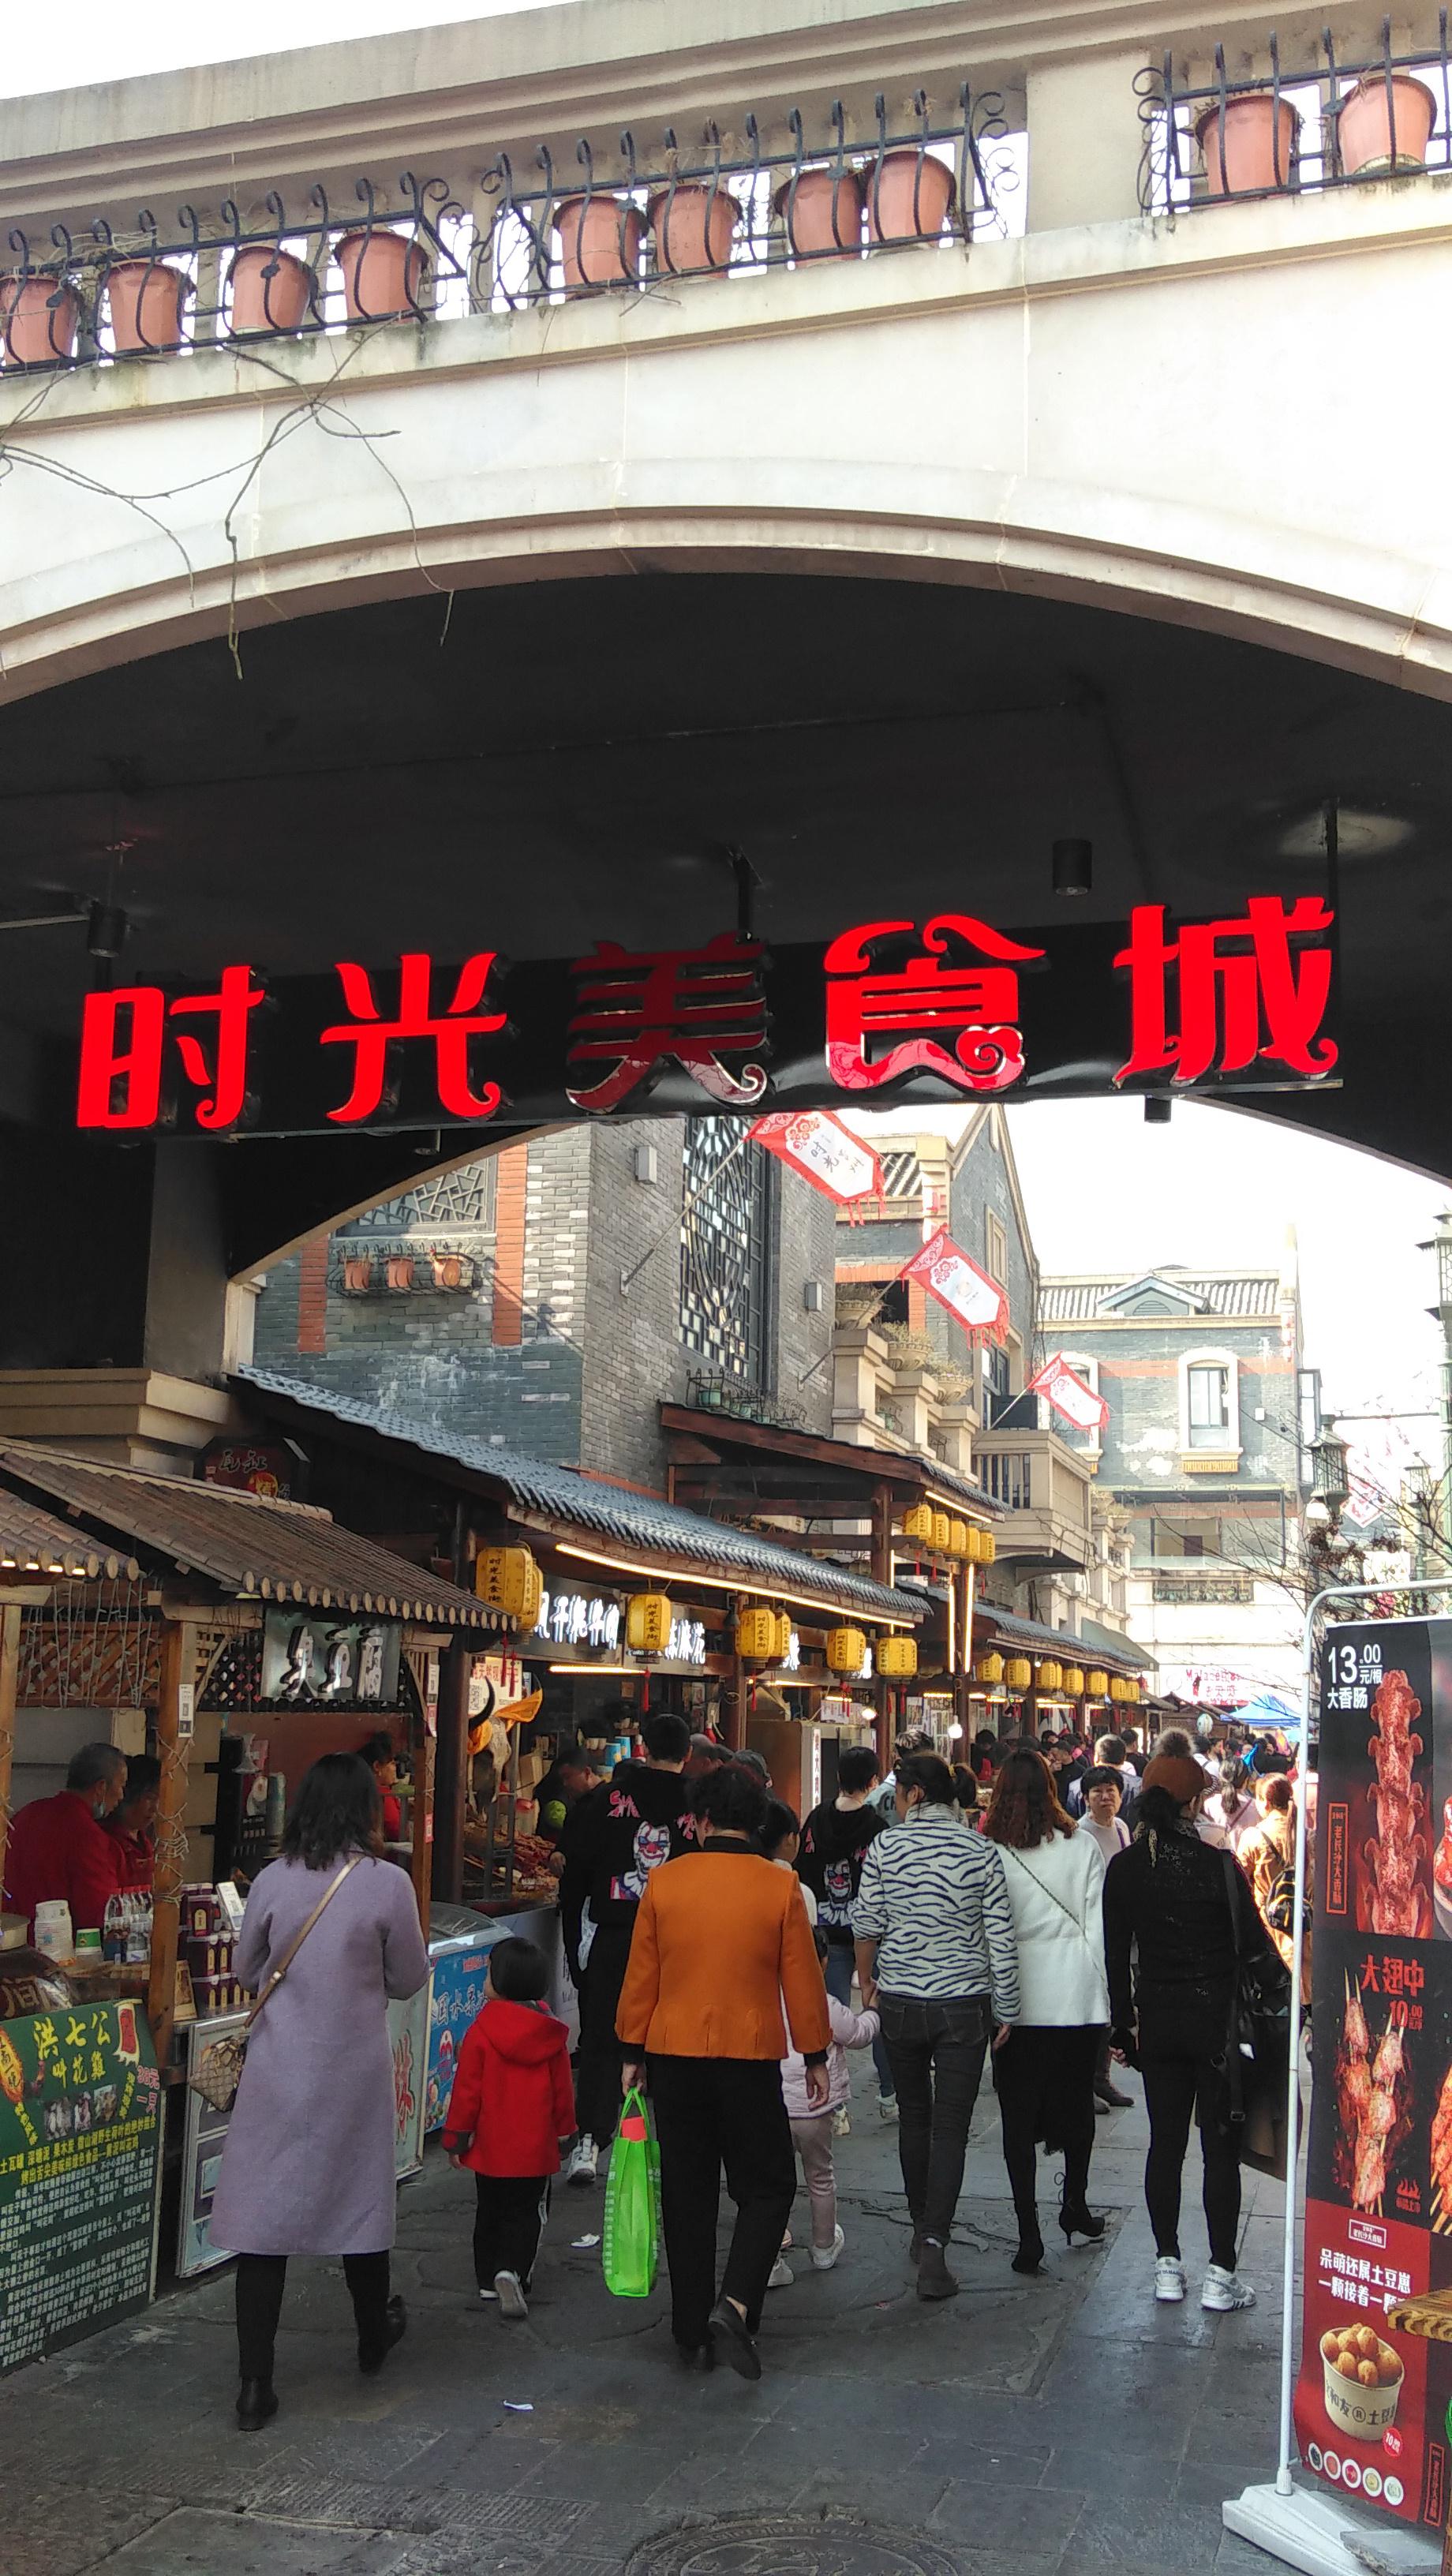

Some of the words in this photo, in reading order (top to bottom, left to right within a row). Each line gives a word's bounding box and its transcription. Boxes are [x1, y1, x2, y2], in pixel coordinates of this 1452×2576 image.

[77, 896, 1338, 1129] 时光美食城
[1327, 1687, 1368, 1710] 大香肠
[1360, 1953, 1425, 1998] 大翅中
[33, 2010, 111, 2060] 洪七公
[1319, 2247, 1411, 2295] 呆萌还属土豆崽
[1317, 2275, 1405, 2315] 一颗接着一颗
